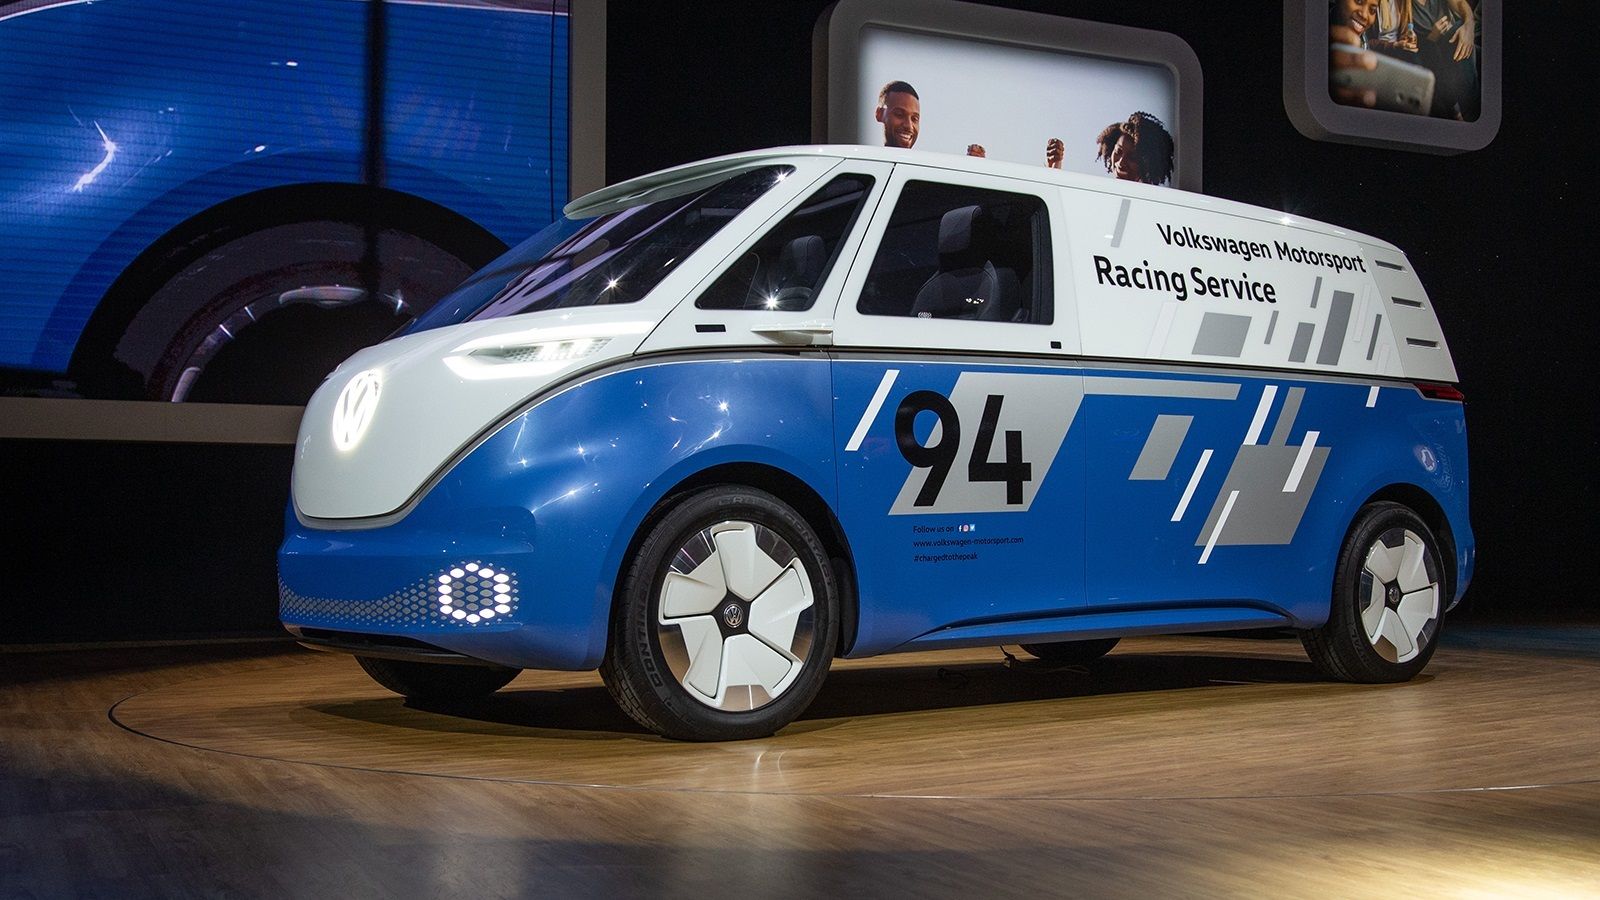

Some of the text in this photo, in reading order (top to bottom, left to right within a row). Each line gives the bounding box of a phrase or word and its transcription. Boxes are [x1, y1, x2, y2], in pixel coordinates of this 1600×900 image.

[1156, 222, 1367, 273] Volkswagen Motorsport
[1093, 254, 1277, 303] Racing Service
[895, 390, 1032, 507] 94
[913, 525, 936, 533] Follow
[913, 536, 1024, 547] www.volkswagen-motorsport.com
[913, 552, 978, 563] #chargedtothepeak
